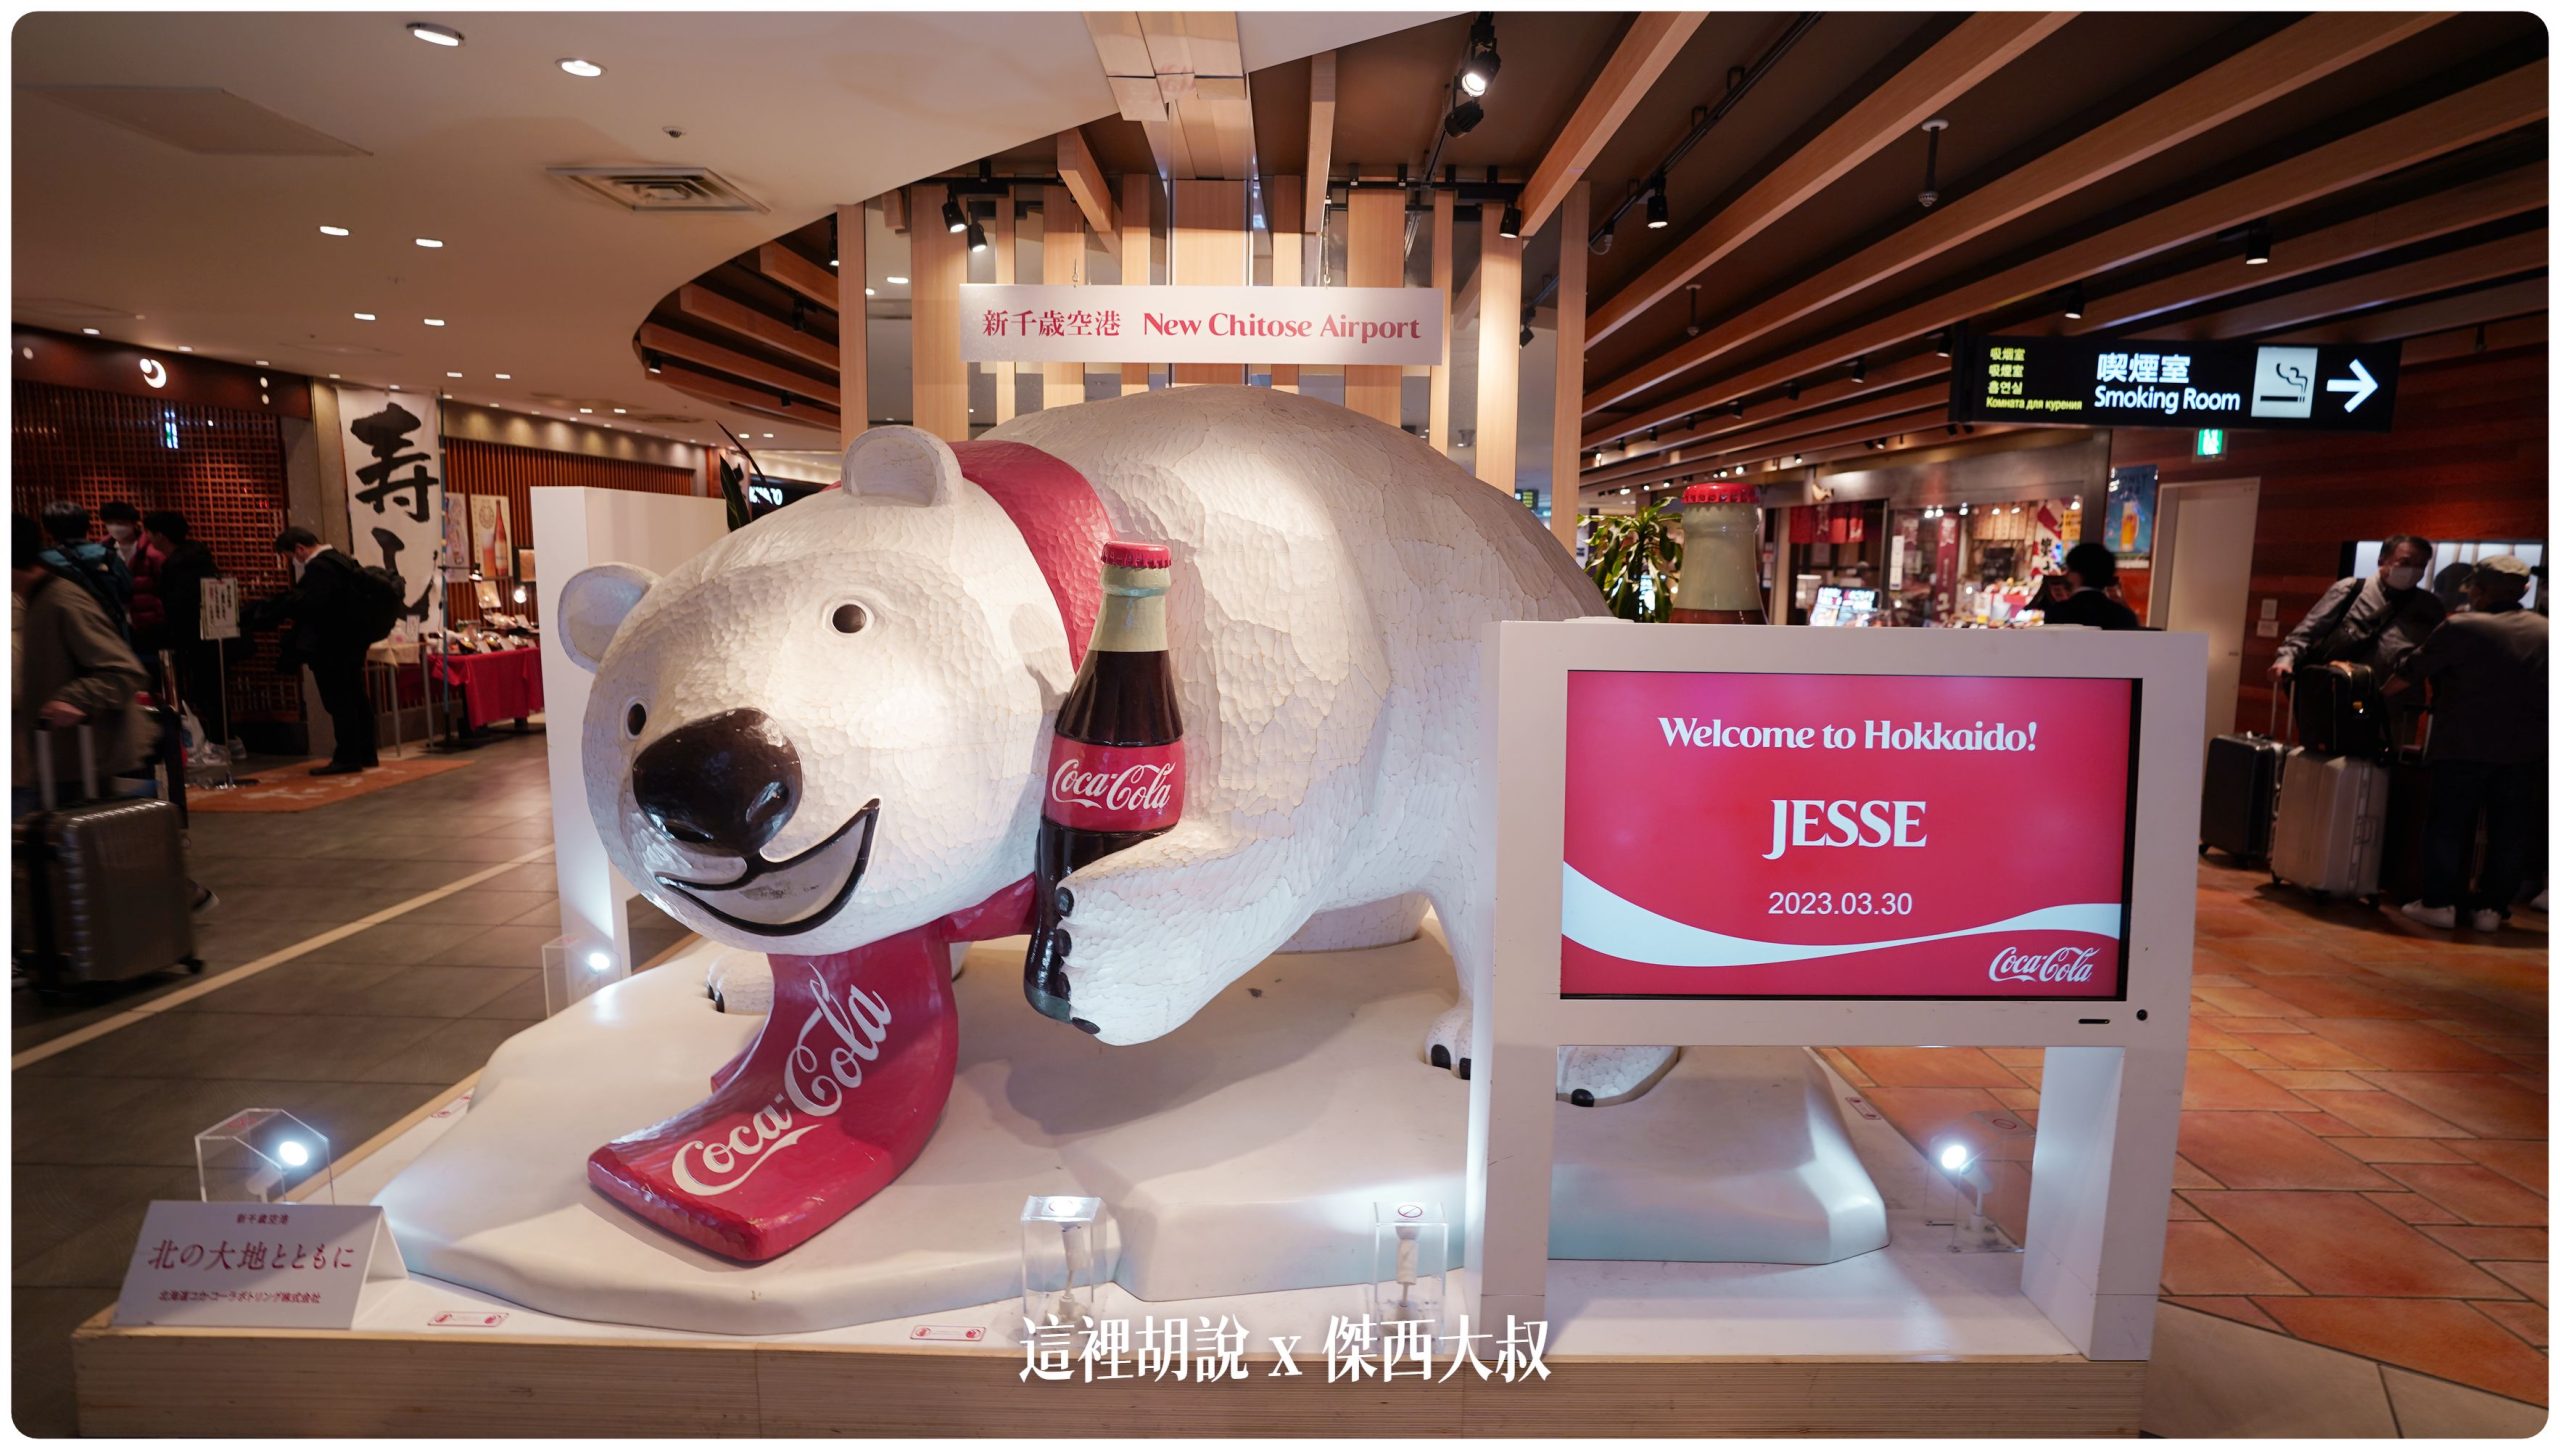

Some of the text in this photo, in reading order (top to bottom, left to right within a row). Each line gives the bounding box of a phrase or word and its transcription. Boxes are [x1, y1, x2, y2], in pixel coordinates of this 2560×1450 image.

[982, 309, 1121, 338] 新千歳空港
[1143, 312, 1422, 345] New Chitose Airport
[2096, 353, 2191, 384] 喫煙室
[1986, 396, 2083, 412] Комната для курения
[2094, 385, 2241, 415] Smoking Room
[1658, 717, 2038, 752] Welcome to Hokkaido!
[1051, 758, 1176, 812] Coca-Cola
[1762, 799, 1928, 861] JESSE
[1767, 891, 1914, 916] 2023.03.30
[1988, 946, 2101, 984] Coca-Cola
[671, 961, 894, 1197] Coca-Cola
[147, 1239, 356, 1272] 北の大地とともに
